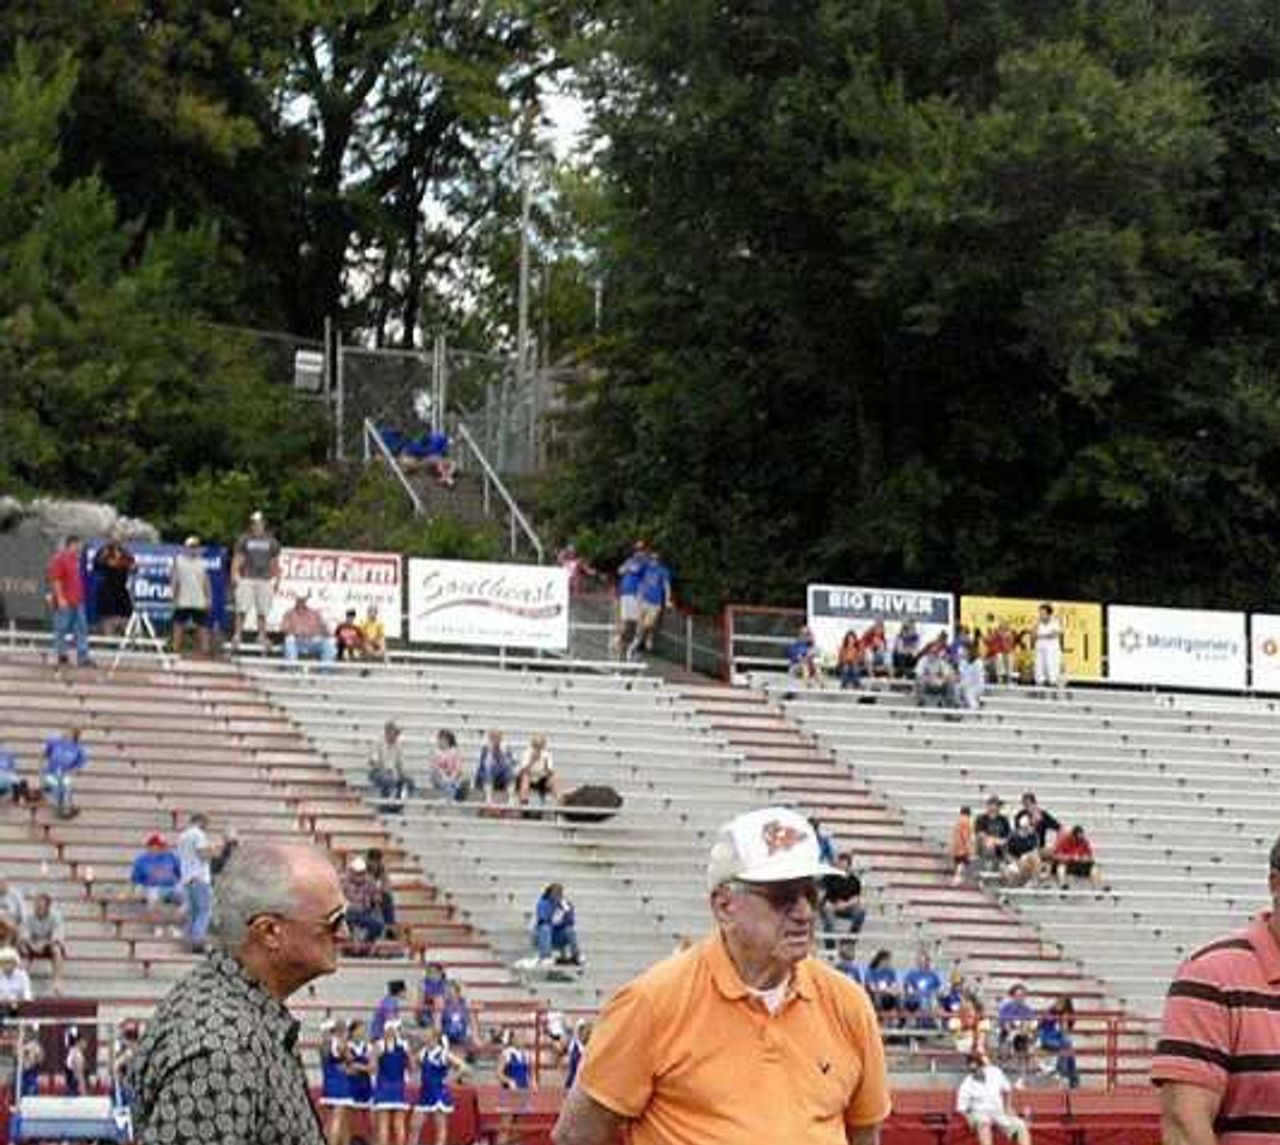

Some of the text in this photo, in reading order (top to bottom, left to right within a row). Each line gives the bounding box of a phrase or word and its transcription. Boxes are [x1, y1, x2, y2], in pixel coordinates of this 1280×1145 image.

[278, 552, 396, 584] State Farm
[828, 591, 933, 615] BIG RIVER
[1146, 633, 1238, 655] Montgomery
